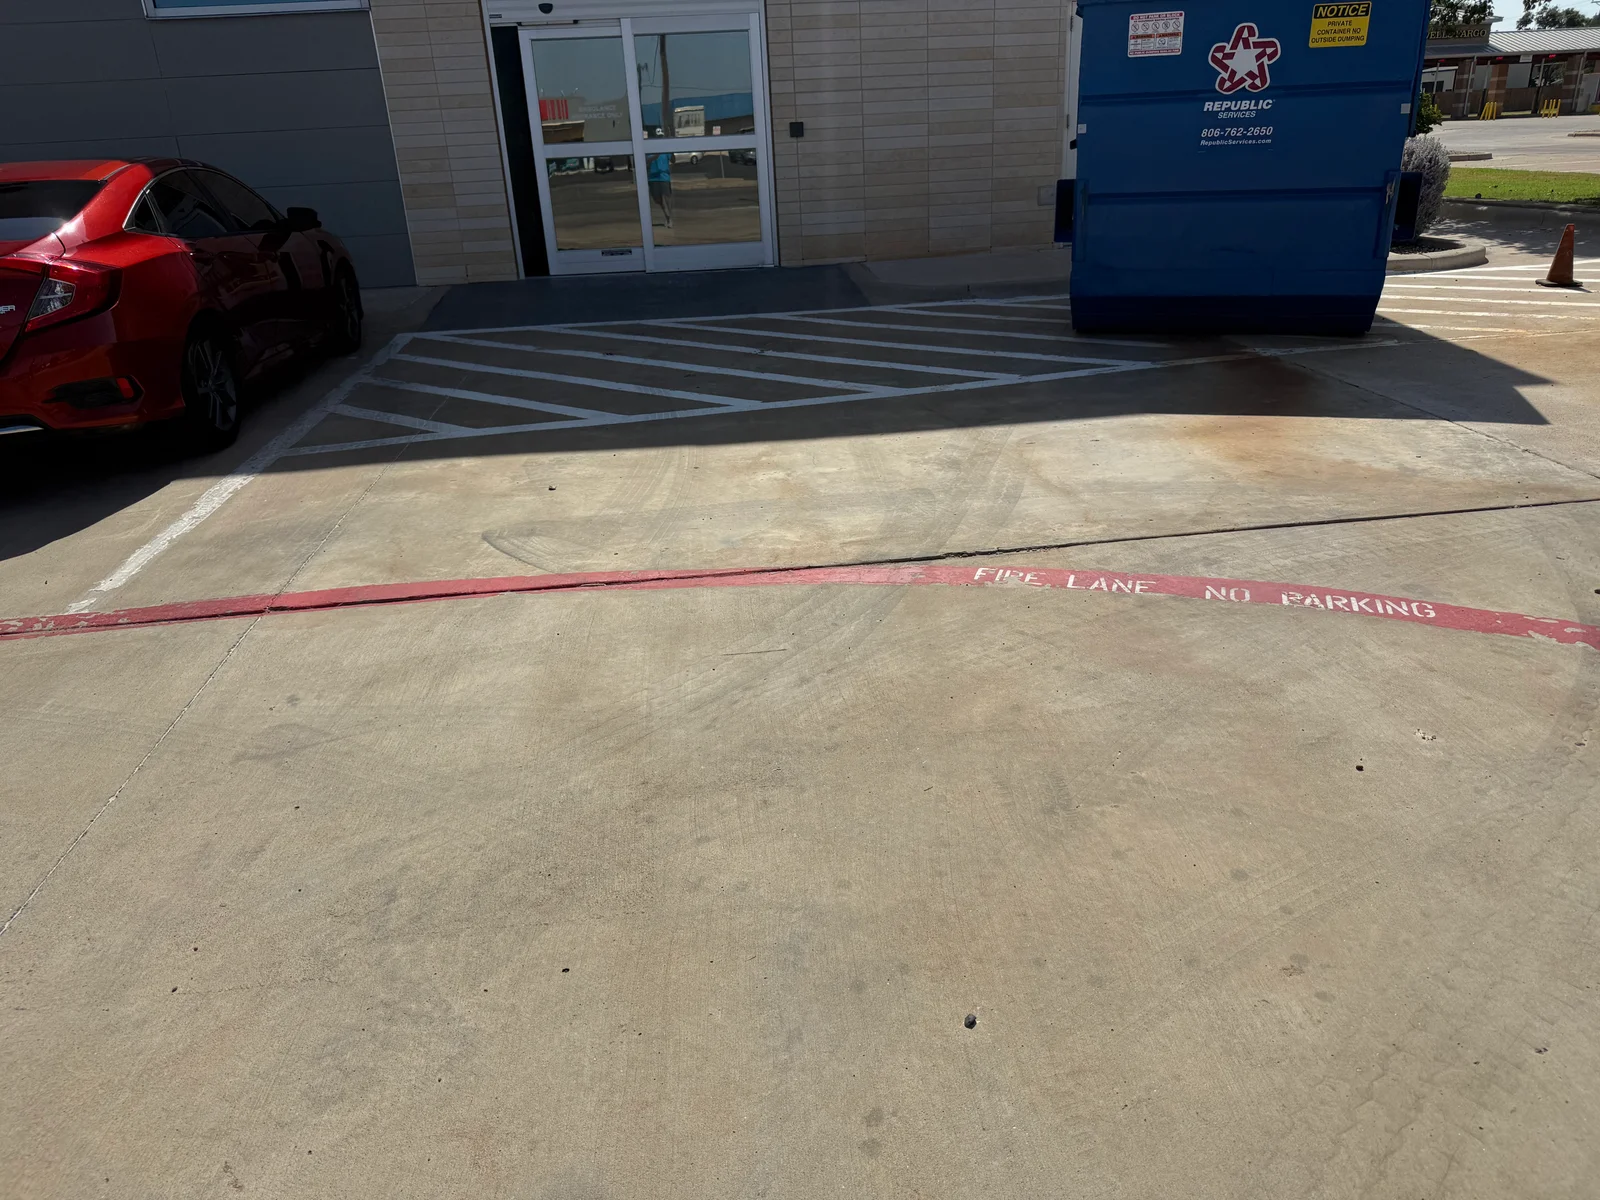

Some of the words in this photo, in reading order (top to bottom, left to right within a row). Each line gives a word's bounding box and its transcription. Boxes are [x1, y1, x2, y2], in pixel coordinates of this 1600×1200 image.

[1316, 4, 1369, 18] NOTICE
[1316, 28, 1351, 36] CONTAINER
[1456, 29, 1487, 38] FARGO
[1311, 36, 1337, 44] OUTSIDE
[1203, 99, 1273, 111] REPUBLIC
[1217, 111, 1256, 119] SERVICES
[1201, 126, 1274, 138] 806-762-2650
[973, 567, 1046, 586] FIRE
[1066, 574, 1157, 594] LANE
[1205, 585, 1251, 602] NO
[1281, 590, 1437, 618] PARKING
